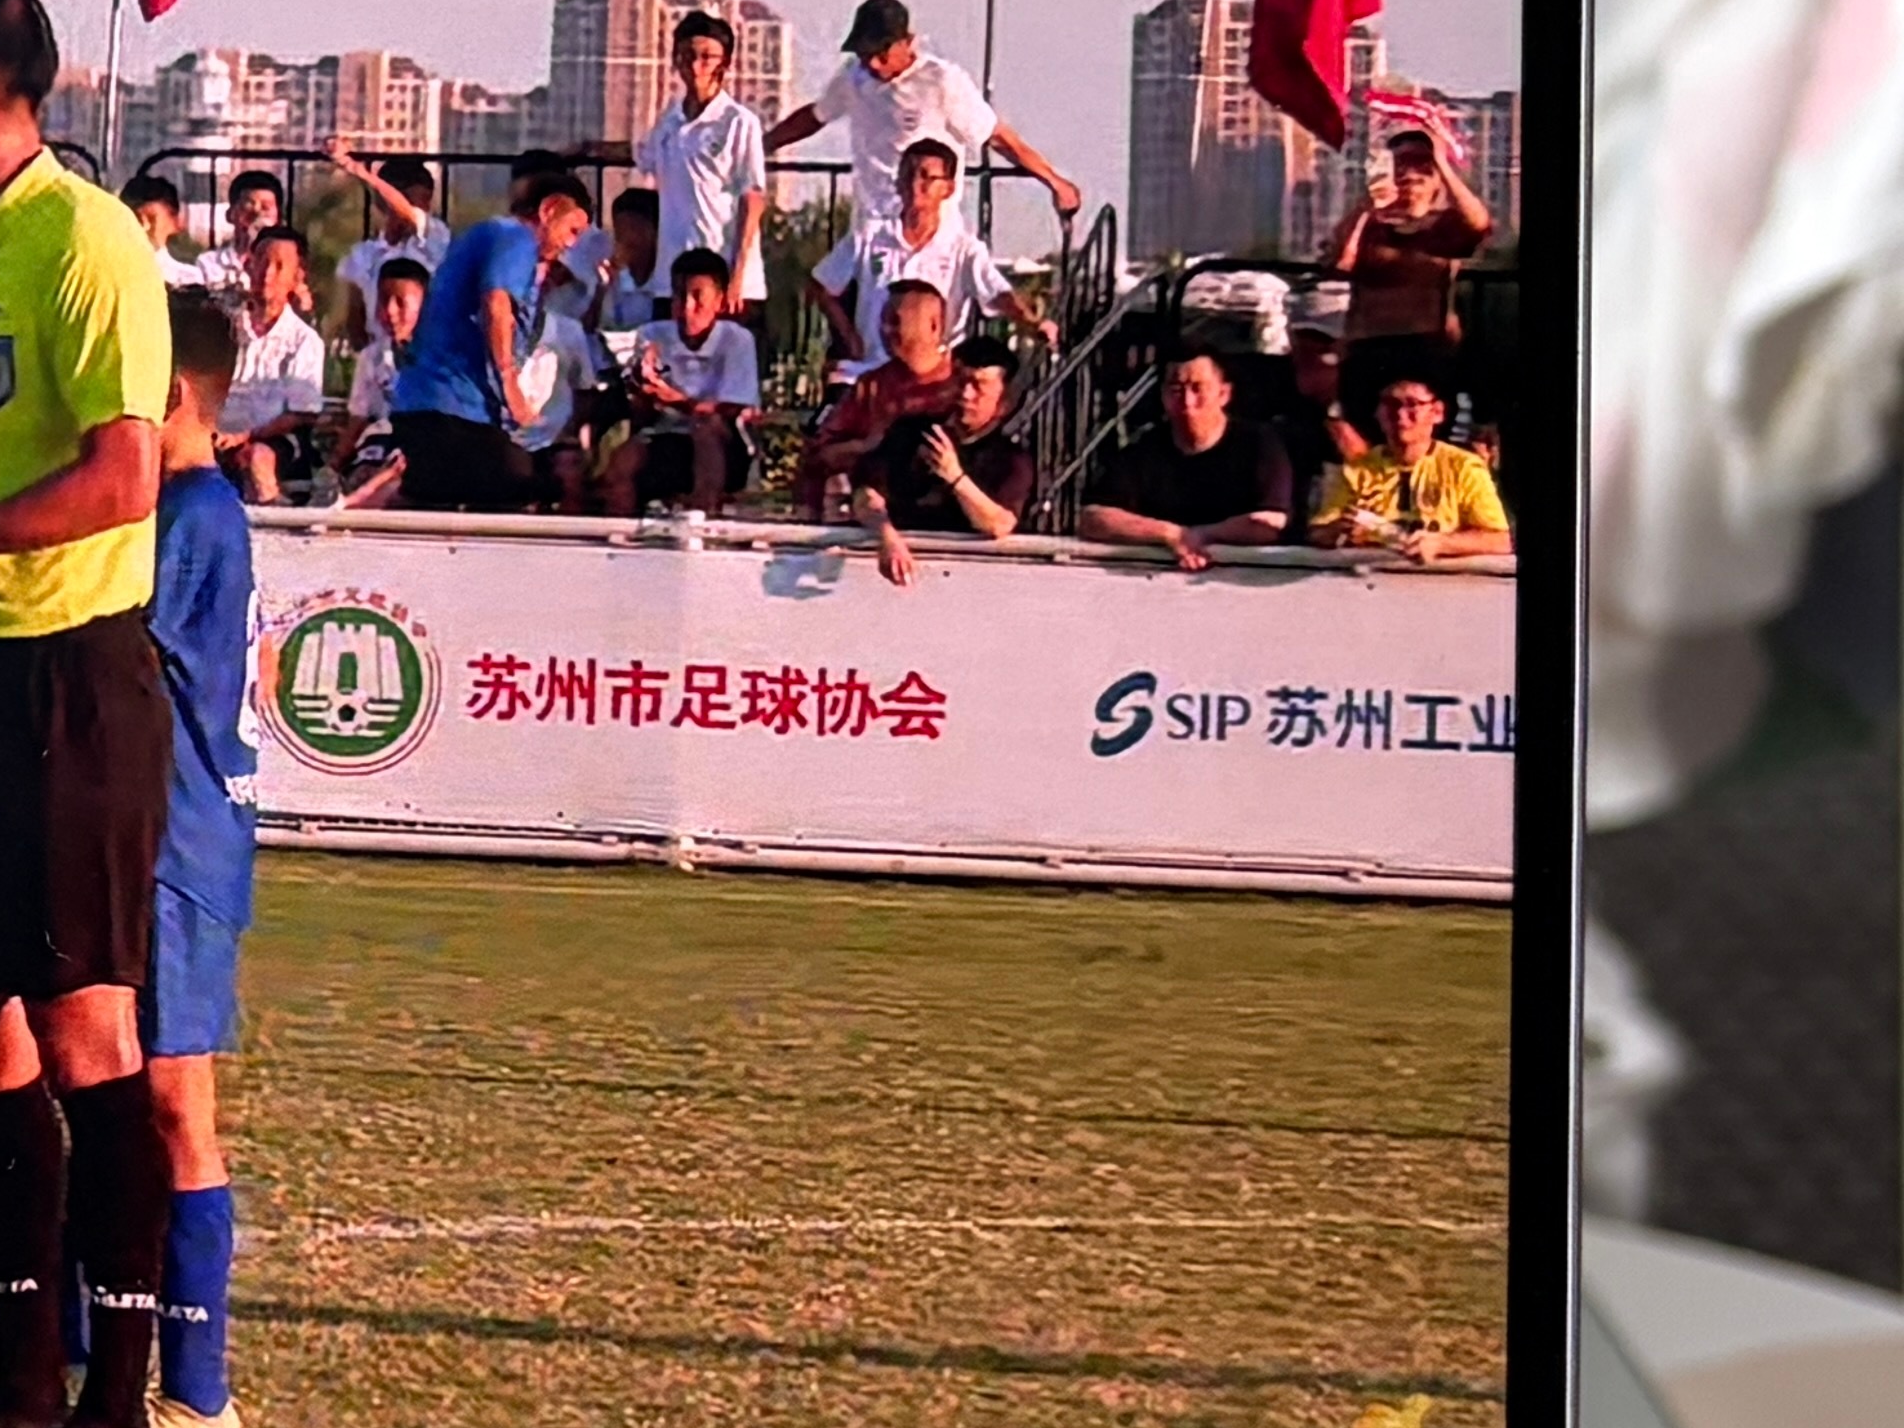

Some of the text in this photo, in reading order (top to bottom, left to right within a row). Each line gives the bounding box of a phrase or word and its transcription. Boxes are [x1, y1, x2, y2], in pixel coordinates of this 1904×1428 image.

[466, 652, 949, 740] 苏州市足球协会
[1165, 684, 1517, 755] SIP 苏州工业
